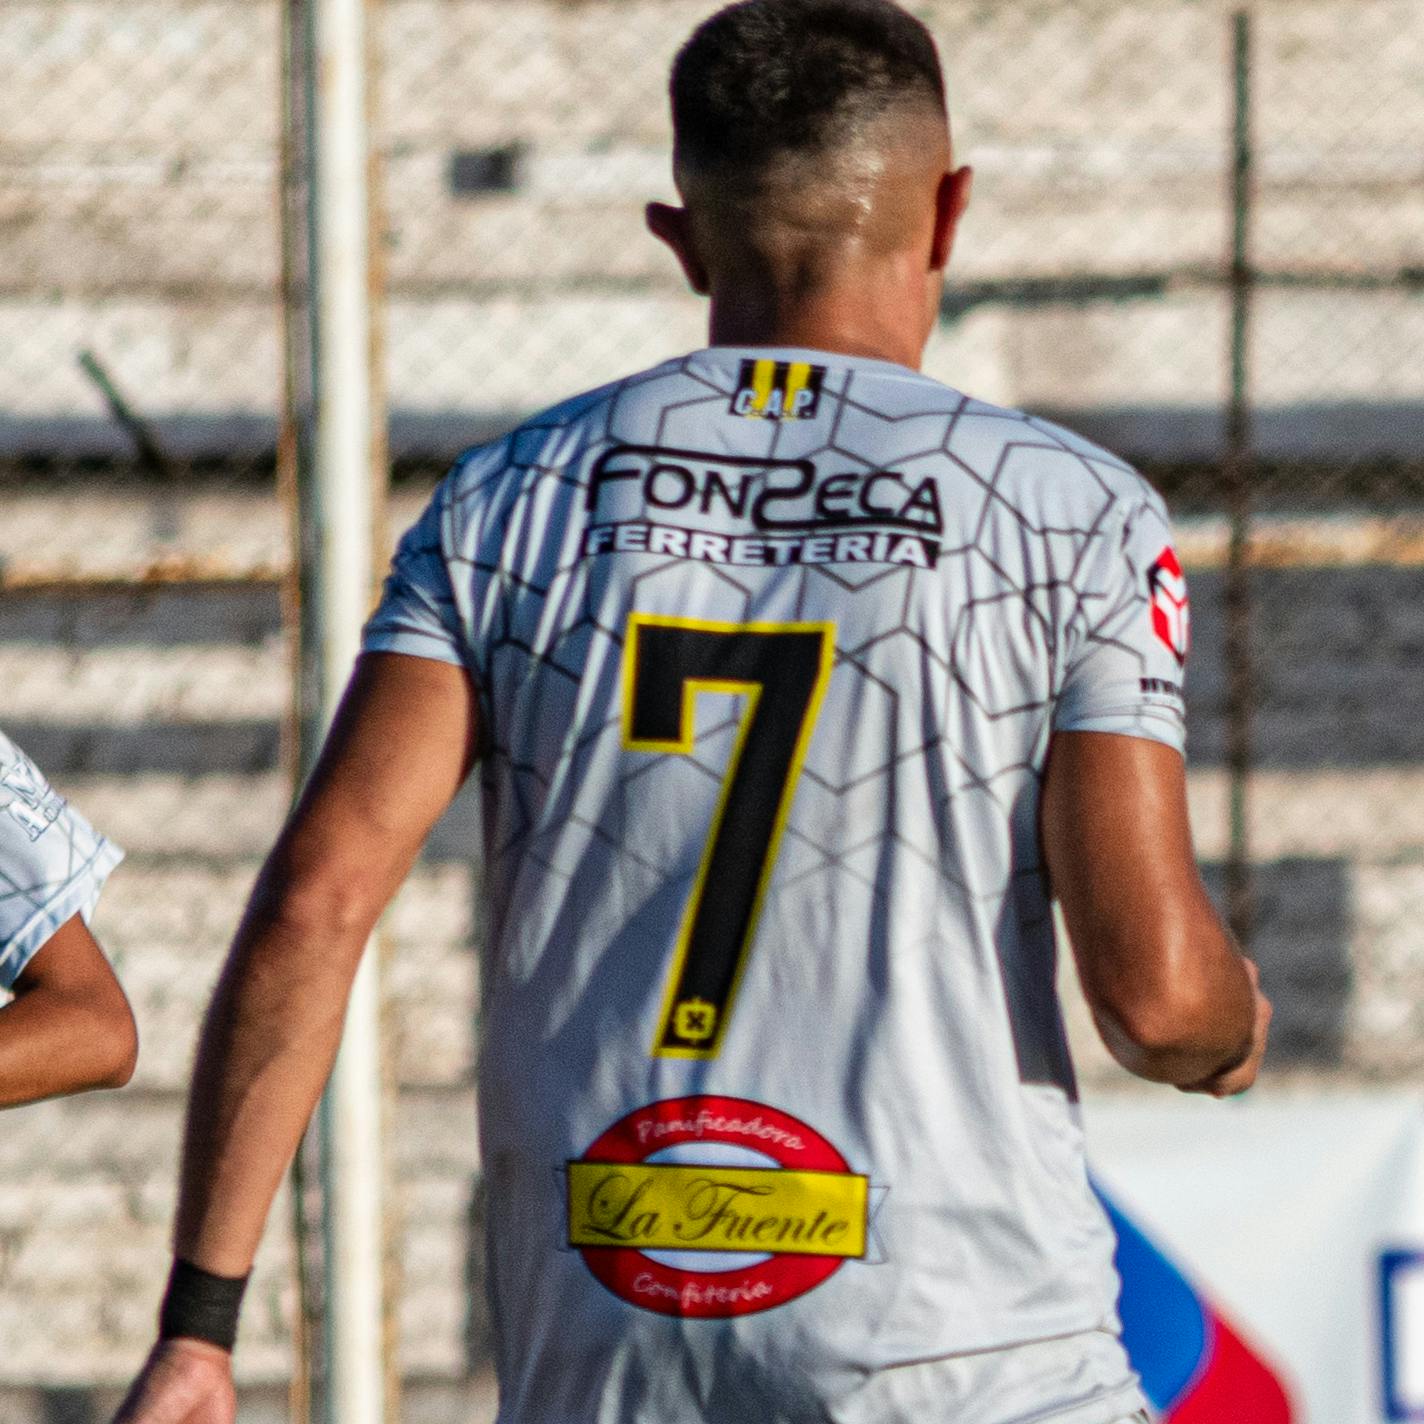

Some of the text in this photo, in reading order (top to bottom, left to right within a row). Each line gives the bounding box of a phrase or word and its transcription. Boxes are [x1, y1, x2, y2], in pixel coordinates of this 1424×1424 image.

[620, 611, 836, 1061] 7
[636, 1110, 806, 1150] Panificadora
[580, 1174, 850, 1246] La Fuente
